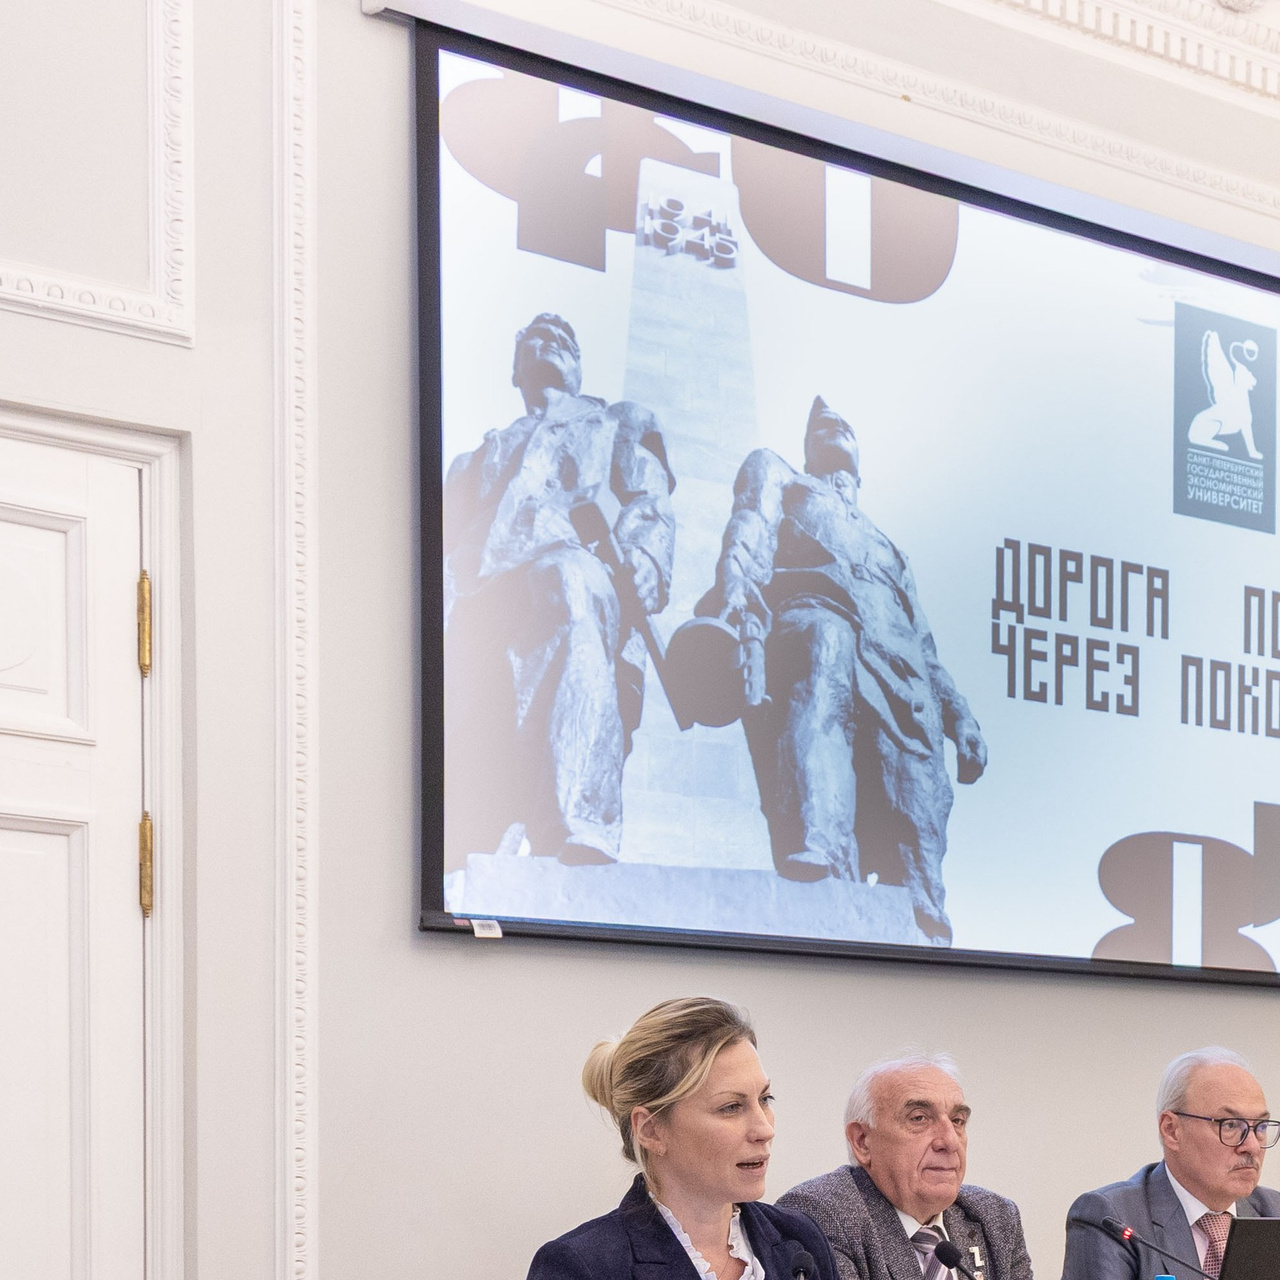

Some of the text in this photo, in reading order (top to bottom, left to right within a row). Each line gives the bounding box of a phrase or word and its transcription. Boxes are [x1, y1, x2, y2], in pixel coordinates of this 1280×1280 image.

[640, 215, 738, 262] 1945
[1187, 453, 1263, 476] САНКТ-ПЕТЕРБУРГСКИЙ
[1187, 463, 1263, 488] ГОСУДАРСТВЕННЫЙ
[1187, 474, 1263, 500] ЭКОНОМИЧЕСКИЙ
[1187, 485, 1263, 514] УНИВЕРСИТЕТ
[992, 537, 1169, 640] ДОРОГА
[991, 621, 1139, 717] ЧЕРЕЗ
